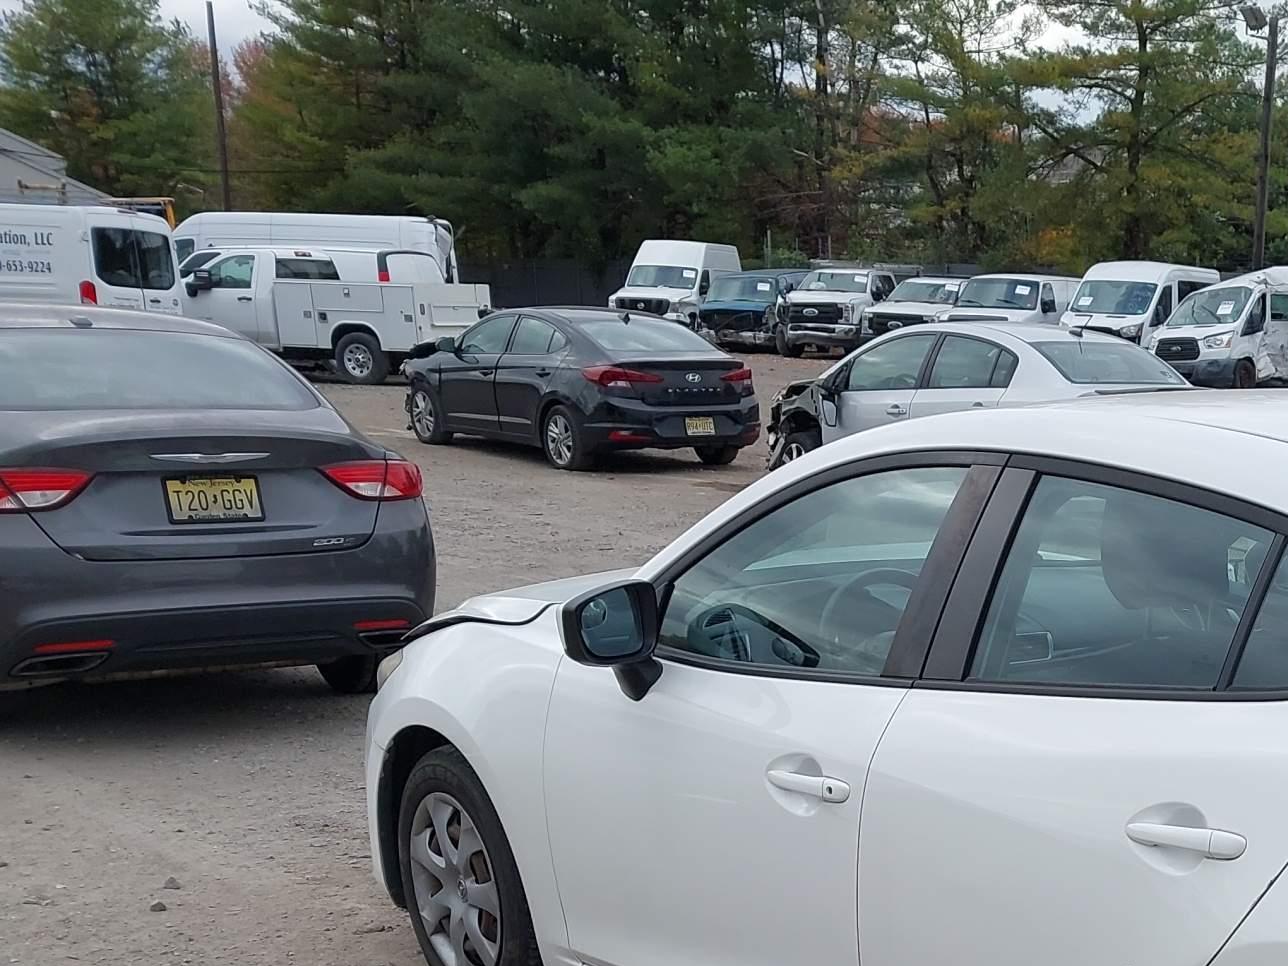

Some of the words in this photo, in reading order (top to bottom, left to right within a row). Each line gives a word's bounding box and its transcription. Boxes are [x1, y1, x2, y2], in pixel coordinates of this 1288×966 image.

[34, 231, 54, 246] LLC
[209, 479, 235, 488] Jersey
[172, 489, 209, 512] T20
[221, 488, 254, 510] GGV
